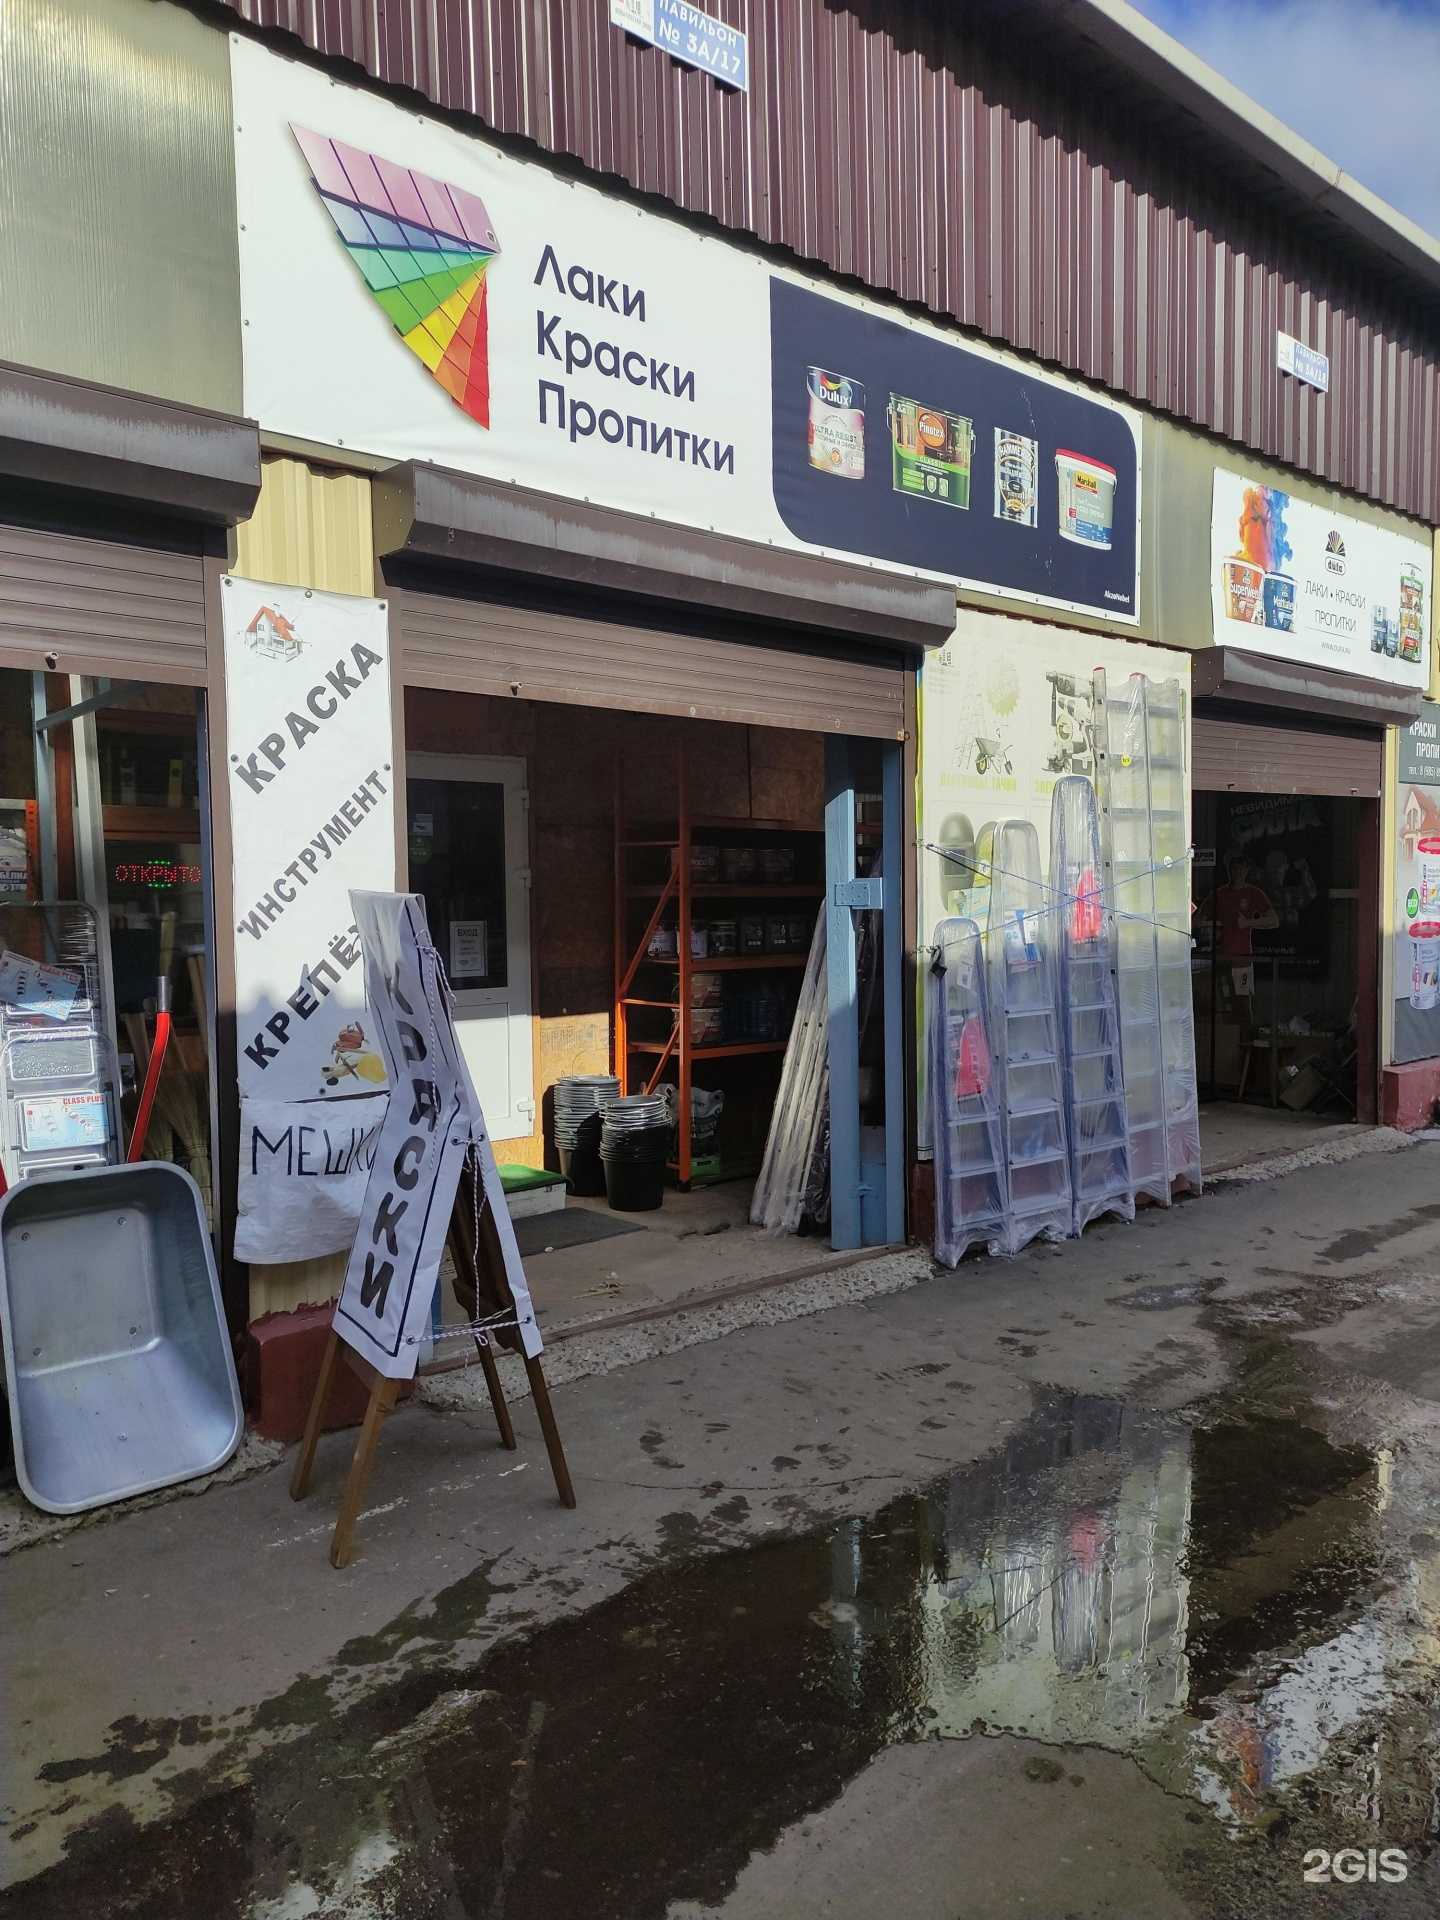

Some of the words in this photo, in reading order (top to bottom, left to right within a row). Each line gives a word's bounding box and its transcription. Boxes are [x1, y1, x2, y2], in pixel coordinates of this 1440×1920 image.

[659, 17, 681, 46] №
[687, 32, 741, 74] 3А/17
[534, 244, 646, 322] Лаки
[537, 310, 695, 402] Краски
[819, 385, 850, 407] Dulux
[539, 379, 734, 475] Пропитки
[919, 420, 945, 438] Pinotex
[1304, 580, 1328, 599] ЛАКИ
[235, 642, 383, 794] КРАСКА
[240, 770, 387, 940] ИНСТРУМЕНТ
[243, 924, 362, 1070] КРЕПЁ
